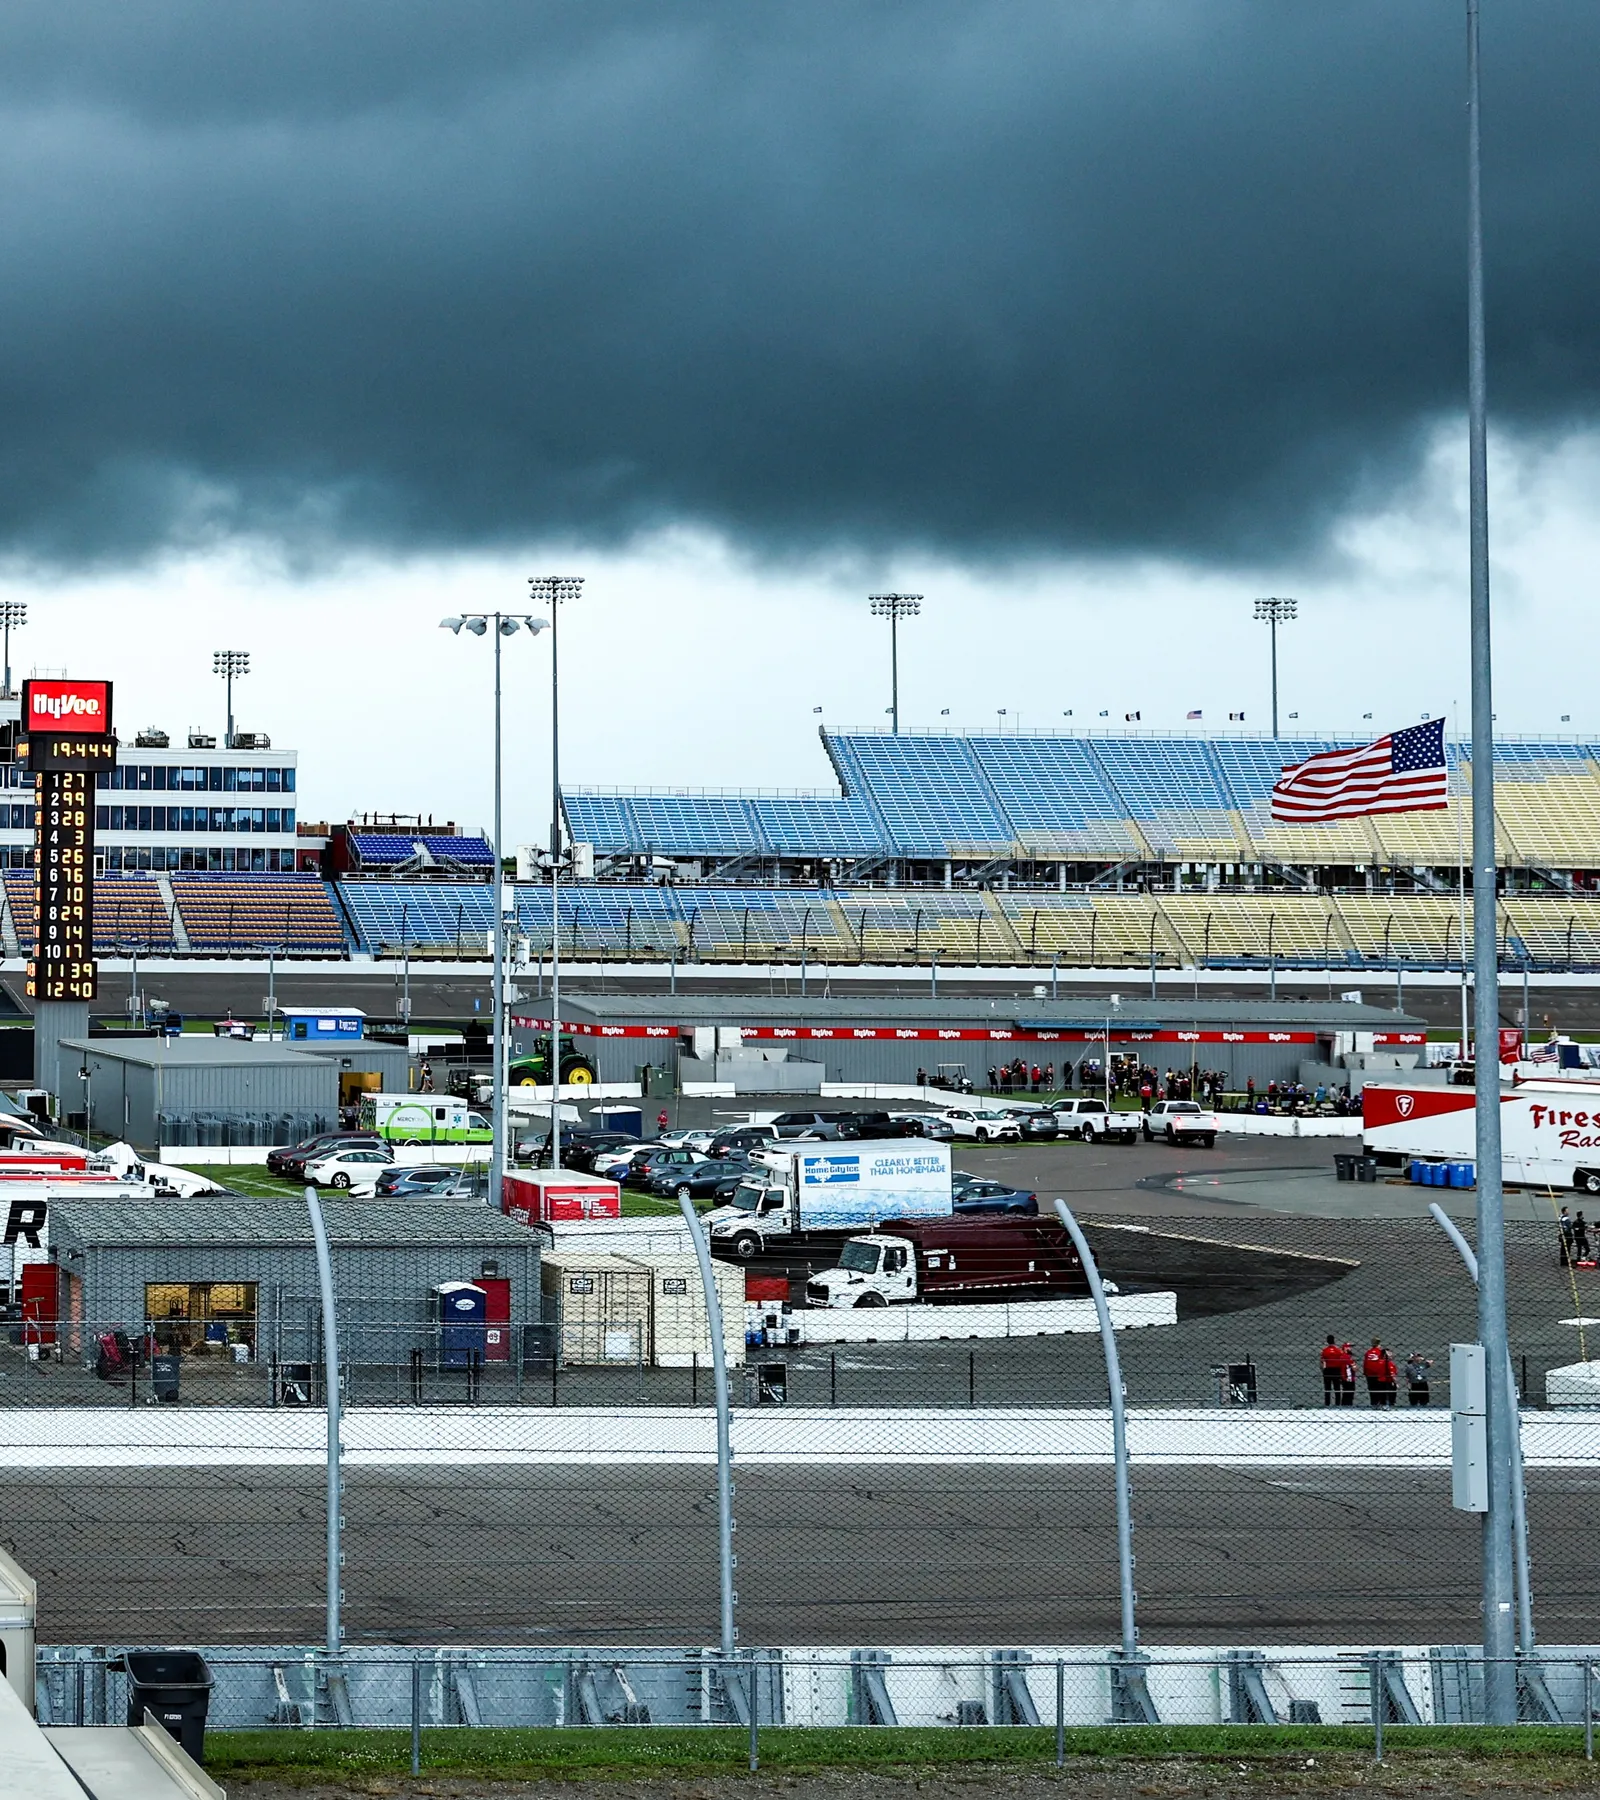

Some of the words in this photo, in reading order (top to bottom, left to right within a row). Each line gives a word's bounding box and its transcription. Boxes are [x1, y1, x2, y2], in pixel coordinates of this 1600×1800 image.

[53, 743, 112, 757] 19.444
[52, 774, 59, 788] 1
[63, 773, 85, 788] 27
[51, 792, 59, 806] 2
[63, 792, 85, 806] 99
[51, 811, 59, 825] 3
[62, 811, 84, 826] 28
[50, 830, 58, 844] 4
[75, 830, 84, 845] 3
[50, 850, 59, 863] 5
[62, 849, 84, 864] 26
[50, 869, 58, 883] 6
[62, 868, 83, 883] 76
[49, 888, 58, 901] 7
[67, 887, 83, 902] 10
[49, 906, 57, 920] 8
[61, 906, 83, 921] 29
[49, 926, 57, 939] 9
[66, 926, 83, 940] 14
[45, 944, 61, 958] 10
[66, 944, 82, 958] 17
[47, 963, 64, 978] 11
[71, 963, 93, 978] 39
[46, 982, 64, 997] 12
[70, 982, 92, 998] 40
[875, 1157, 911, 1167] CLEARLY
[913, 1156, 940, 1165] BETTER
[869, 1166, 894, 1176] THAN
[896, 1164, 946, 1175] HOMEMADE
